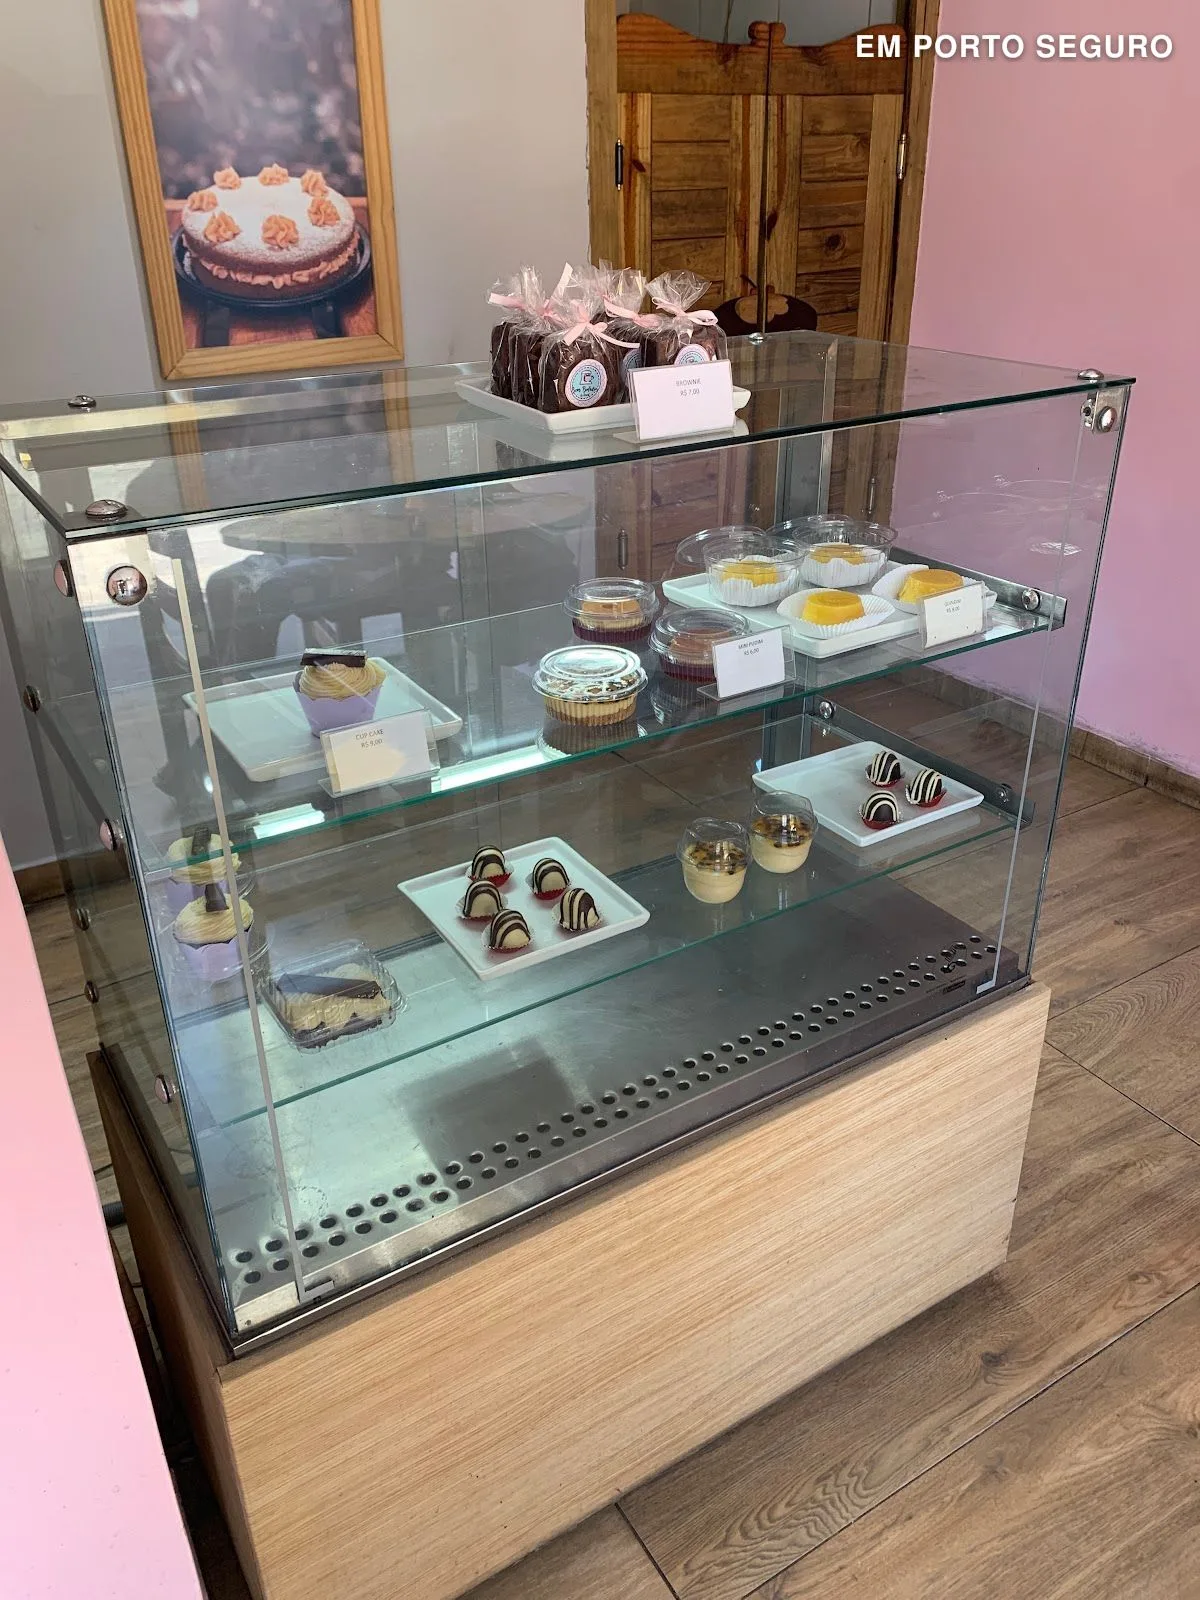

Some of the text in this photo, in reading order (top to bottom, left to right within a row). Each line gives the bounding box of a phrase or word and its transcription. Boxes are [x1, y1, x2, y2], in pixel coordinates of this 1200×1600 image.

[355, 729, 384, 740] CUP CAKE
[369, 738, 383, 747] 9,00
